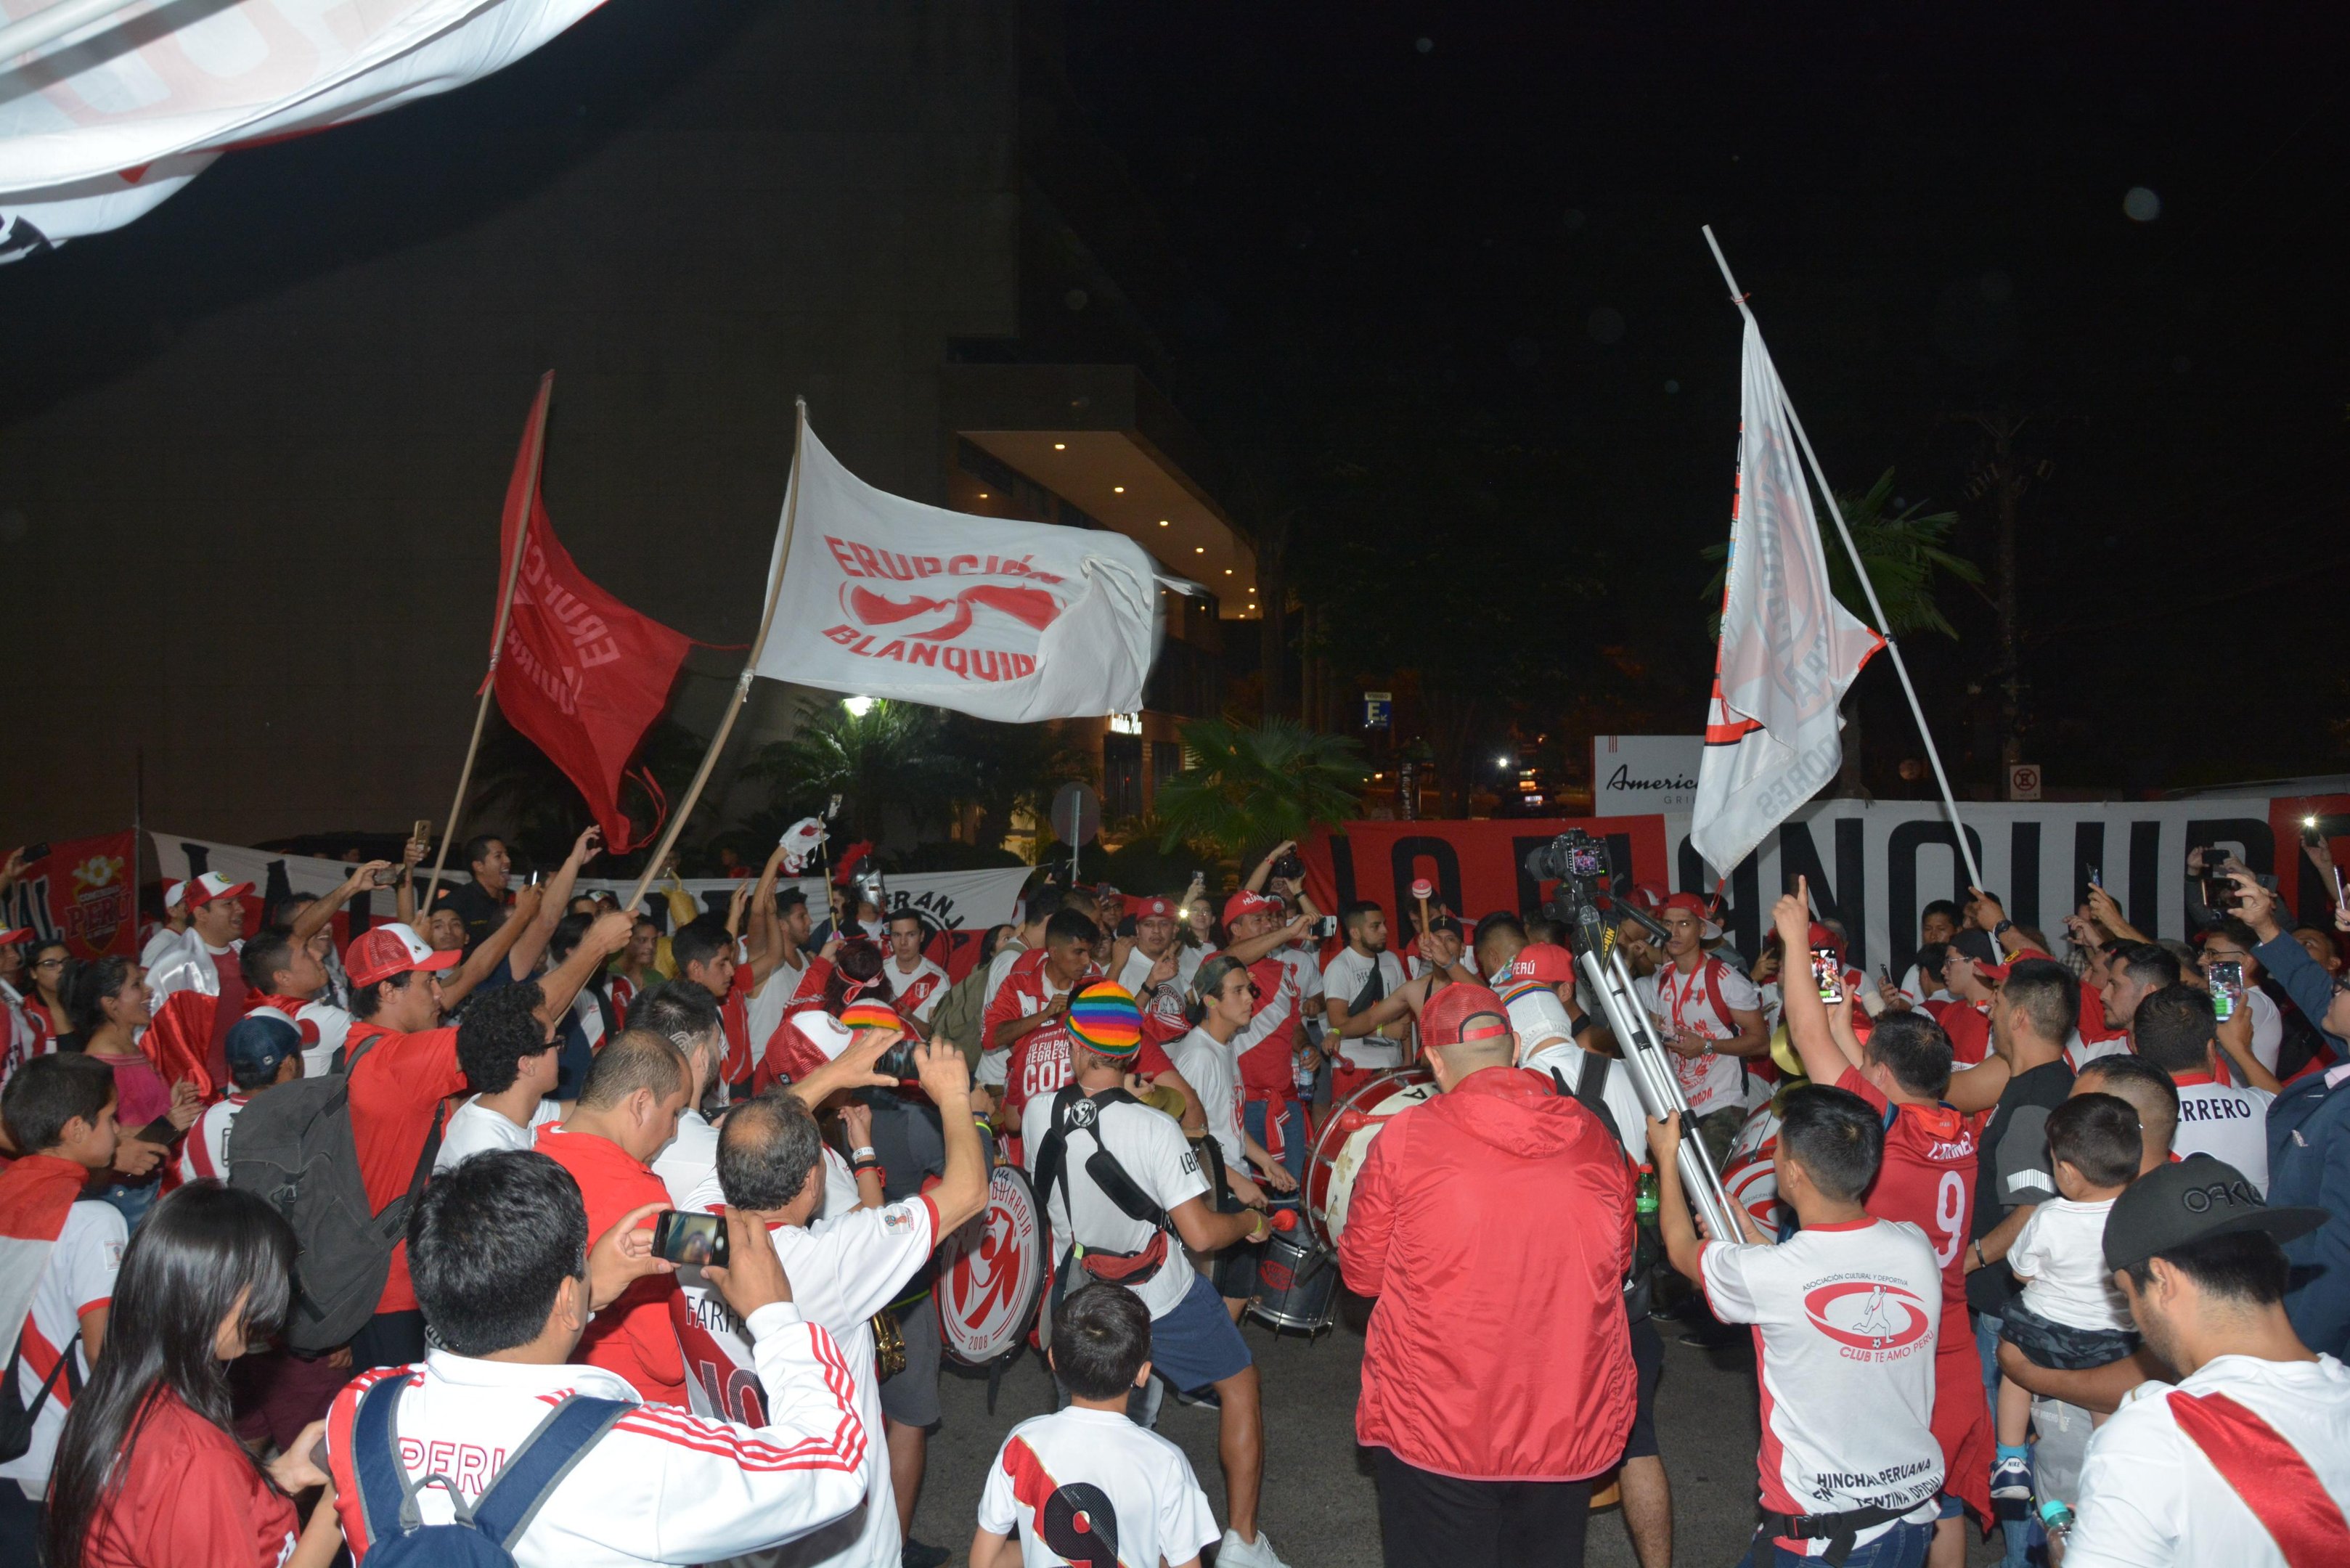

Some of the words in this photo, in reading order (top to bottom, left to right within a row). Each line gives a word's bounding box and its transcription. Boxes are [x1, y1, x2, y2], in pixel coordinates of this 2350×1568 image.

[1368, 702, 1380, 721] E
[1511, 960, 1535, 975] PERÚ
[1038, 1041, 1052, 1051] FUI
[2177, 1098, 2251, 1122] RRERO
[1935, 1170, 1966, 1269] 9
[1803, 1273, 1843, 1291] ASOCIACIÓN
[1877, 1275, 1909, 1286] DEPORTIVA
[968, 1334, 988, 1351] 2008
[1840, 1346, 1872, 1363] CLUB
[1874, 1352, 1885, 1363] TE
[1886, 1347, 1911, 1362] AMO
[1913, 1329, 1935, 1353] PERÚ
